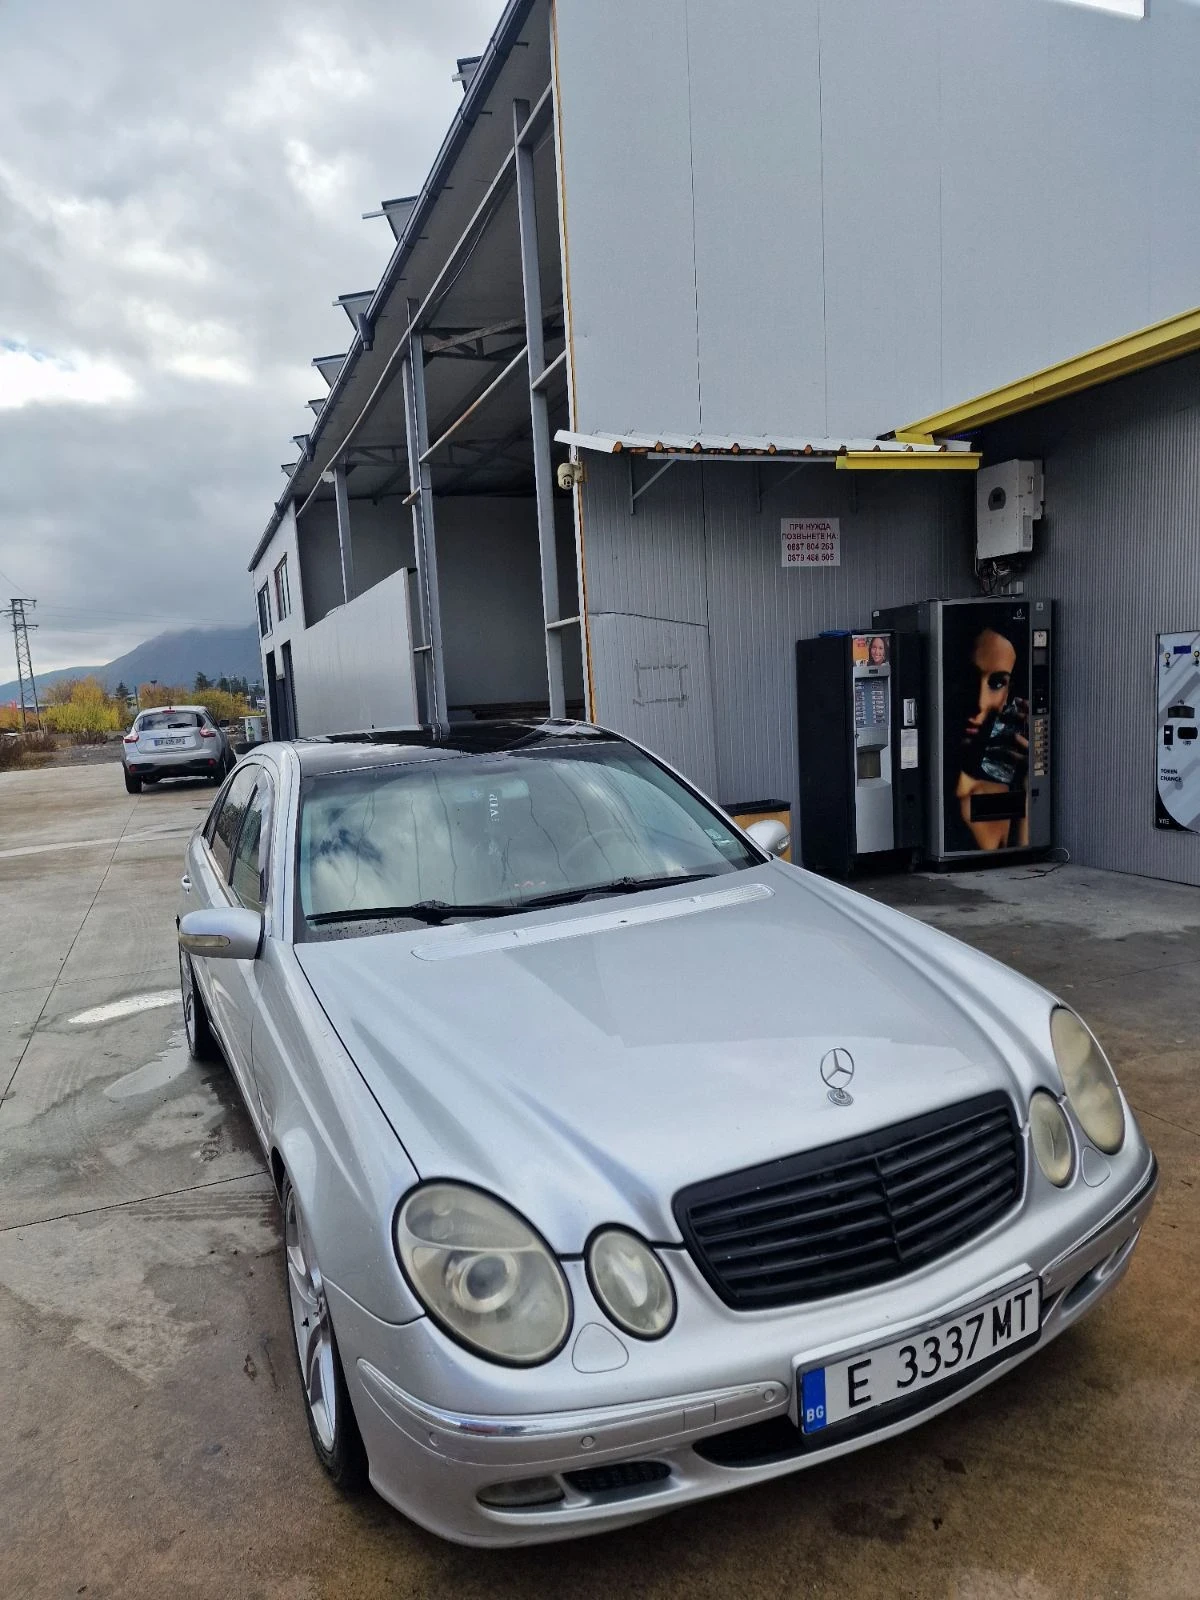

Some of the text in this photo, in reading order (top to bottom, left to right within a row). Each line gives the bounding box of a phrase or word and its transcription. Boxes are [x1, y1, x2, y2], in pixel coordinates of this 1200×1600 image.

[789, 523, 831, 531] ПРИ НУЖДА
[1160, 775, 1183, 783] CHANGE
[847, 1288, 1033, 1409] E 3337 MT
[806, 1404, 825, 1423] BG
